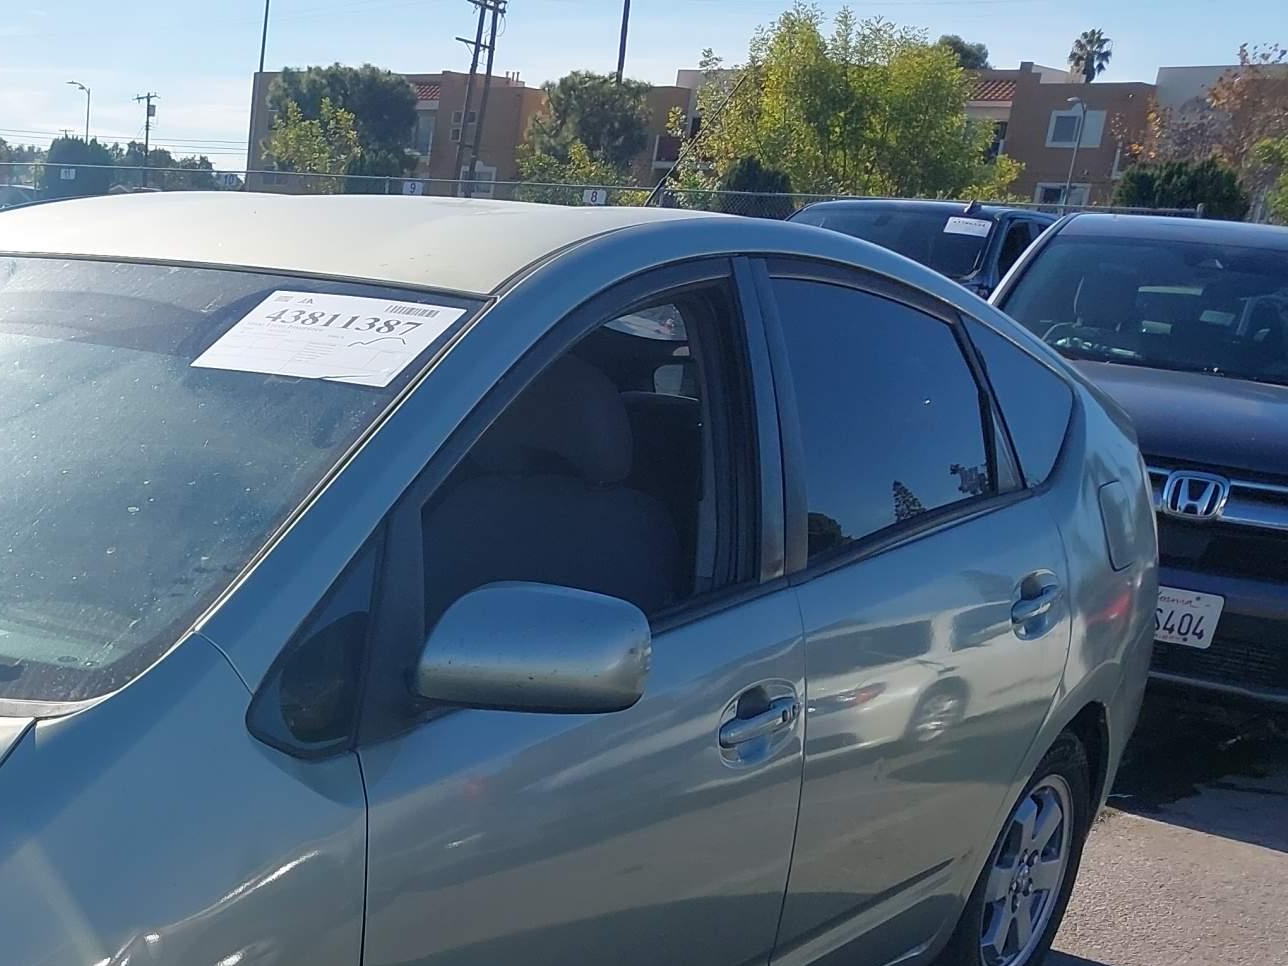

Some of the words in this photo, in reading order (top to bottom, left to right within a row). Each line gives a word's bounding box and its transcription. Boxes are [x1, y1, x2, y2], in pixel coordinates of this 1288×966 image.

[224, 174, 234, 185] 10
[410, 182, 416, 194] 9
[590, 190, 598, 203] 8
[264, 308, 424, 336] 43811387
